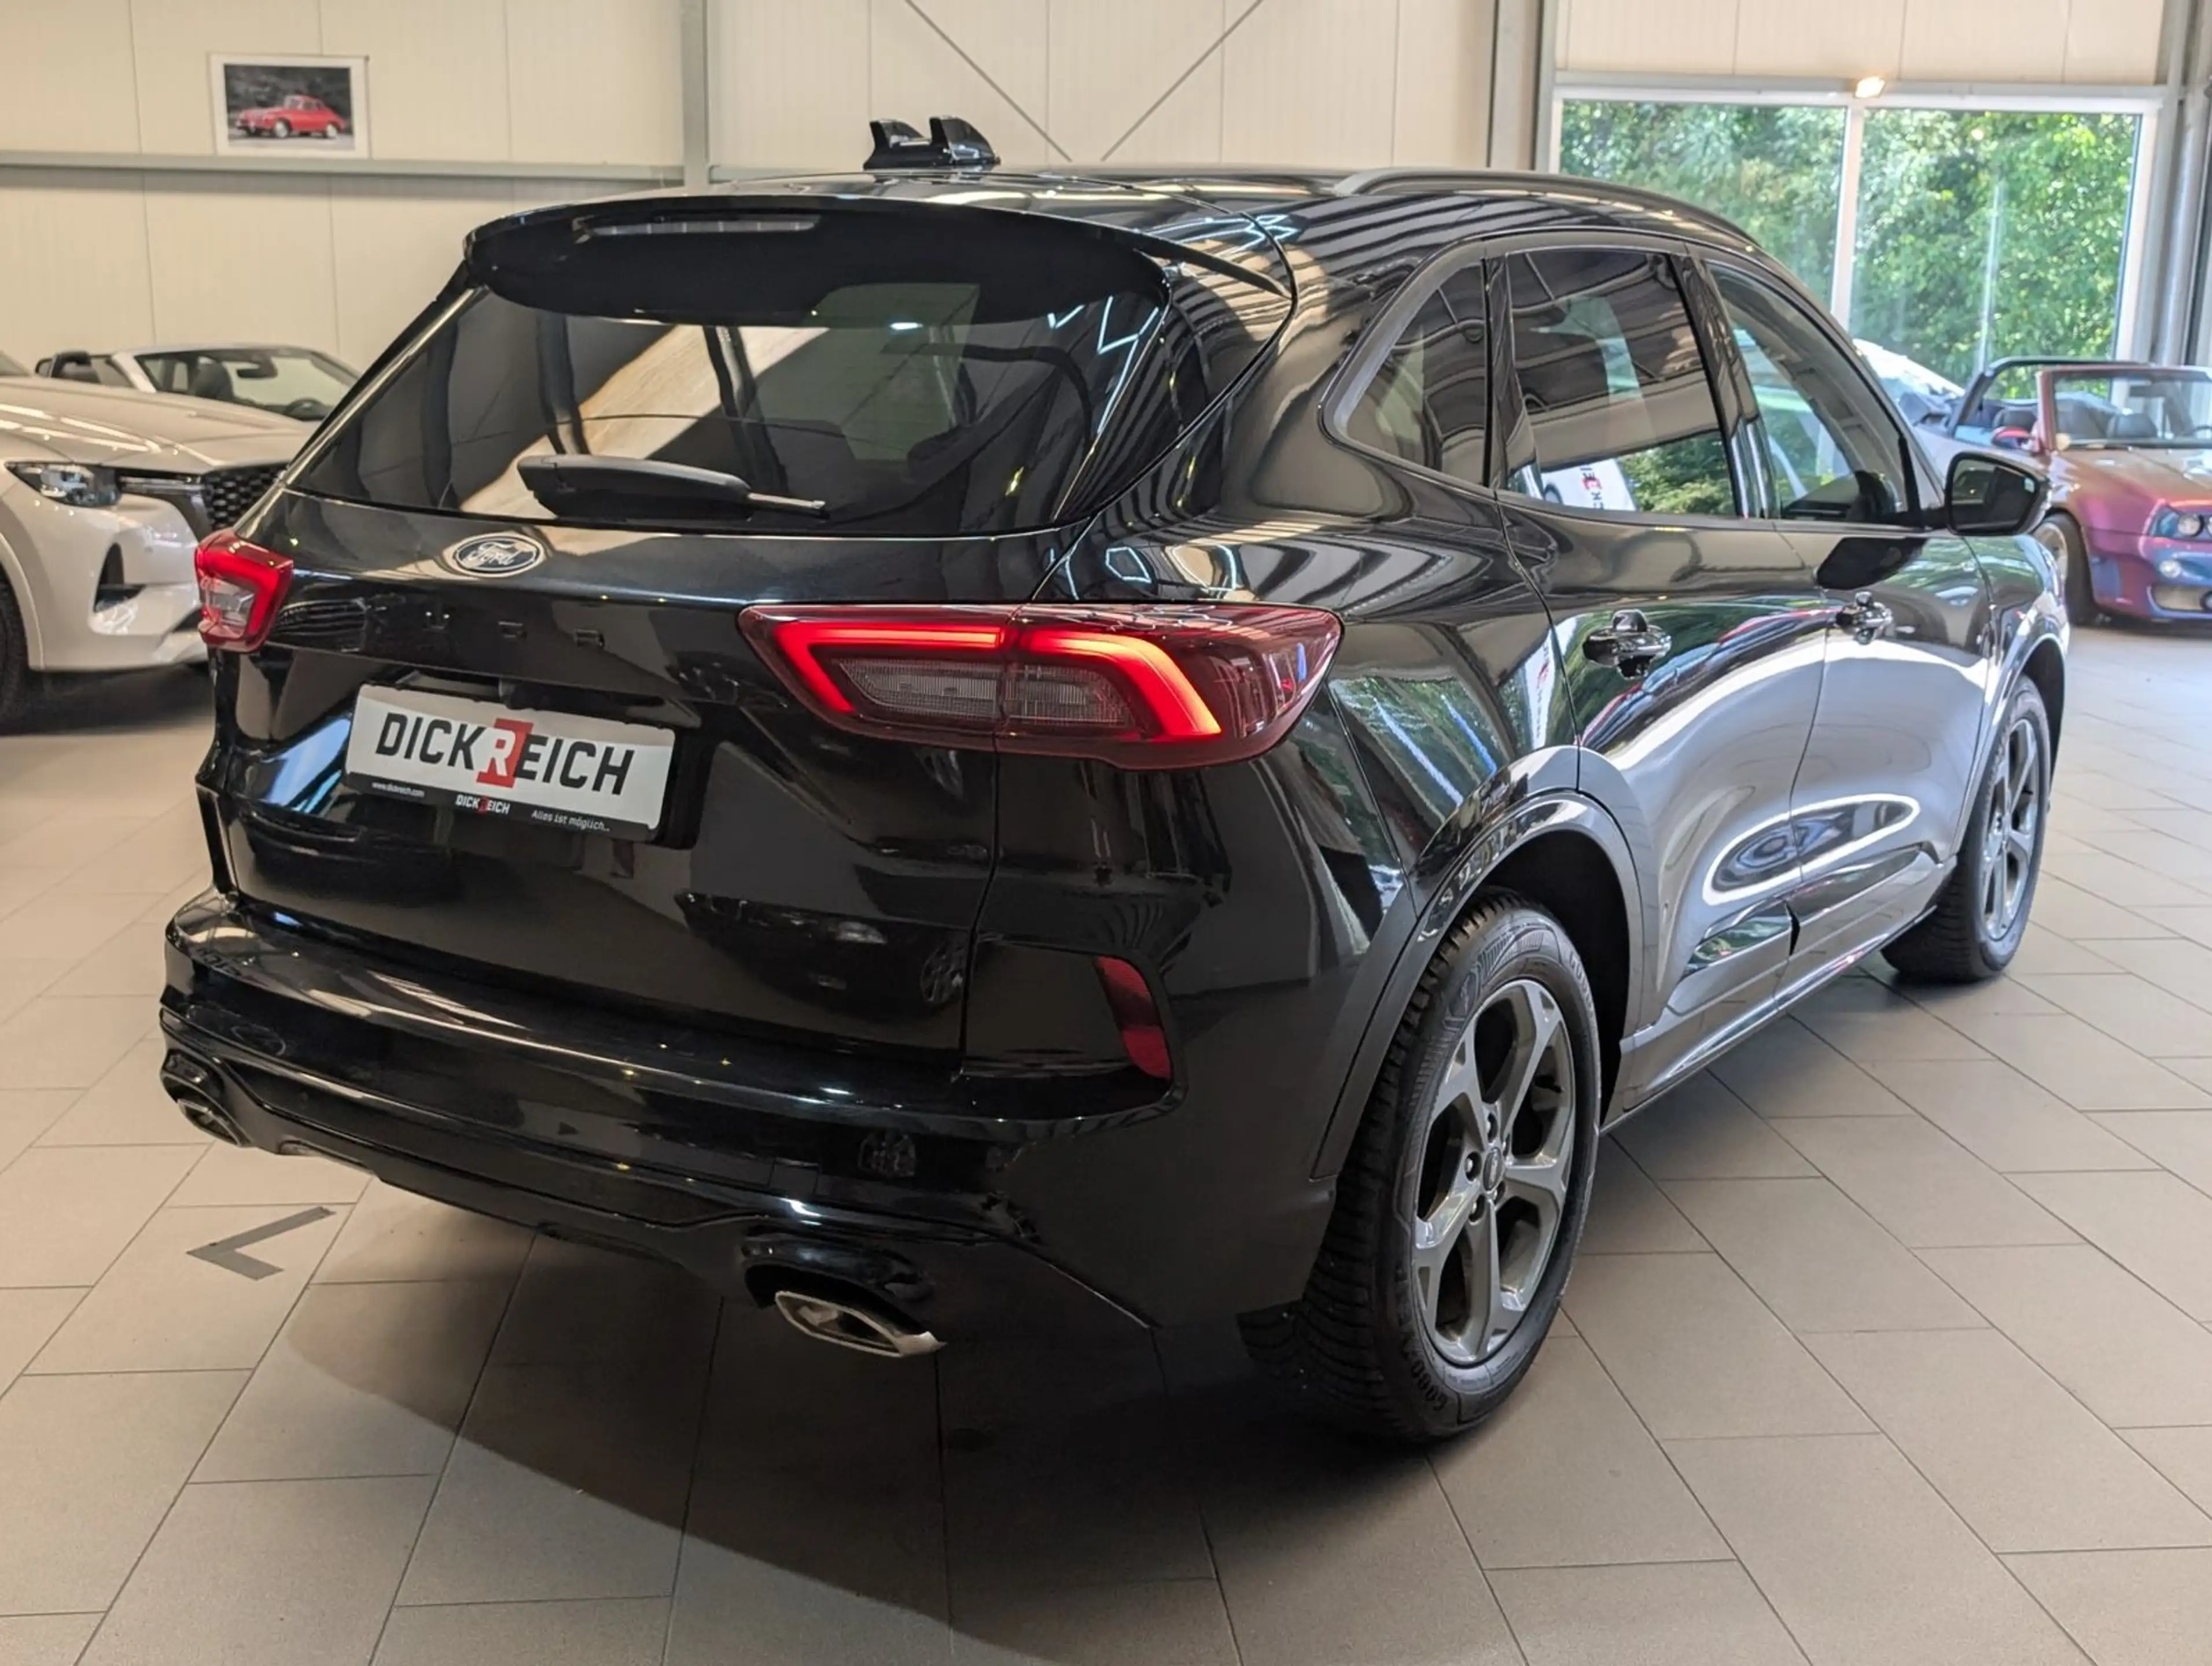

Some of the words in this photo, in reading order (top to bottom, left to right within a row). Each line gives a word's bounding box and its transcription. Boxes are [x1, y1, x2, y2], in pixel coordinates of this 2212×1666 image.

[462, 541, 520, 565] Ford
[375, 712, 635, 795] DICKREICH
[531, 810, 552, 822] Alles
[554, 813, 566, 824] ist
